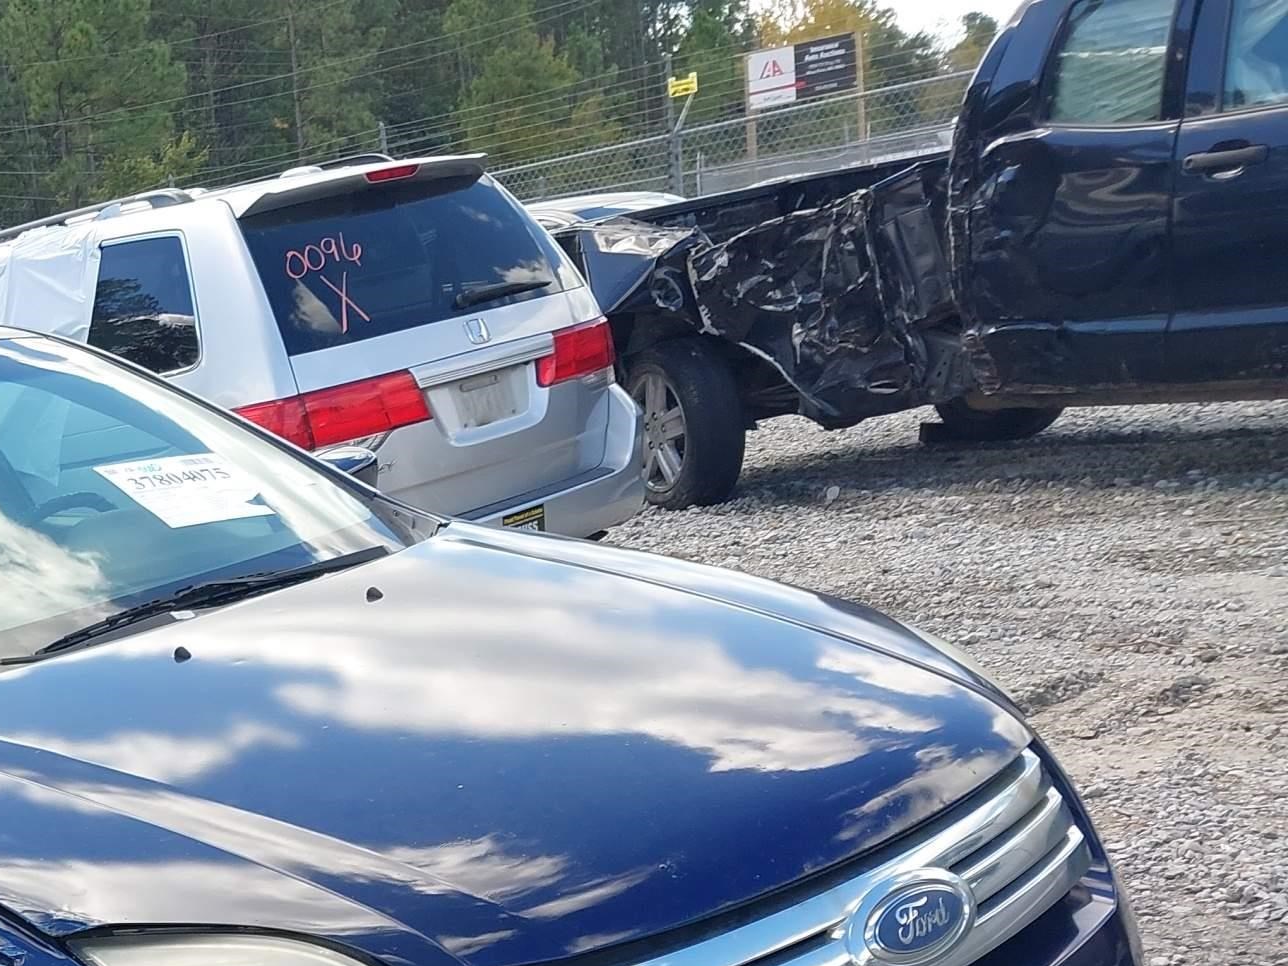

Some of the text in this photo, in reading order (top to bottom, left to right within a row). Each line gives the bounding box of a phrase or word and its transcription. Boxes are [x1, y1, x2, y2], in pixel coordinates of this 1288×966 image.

[286, 231, 362, 279] 0096
[319, 271, 371, 335] X
[127, 467, 232, 490] 37804075
[895, 895, 950, 945] Ford
